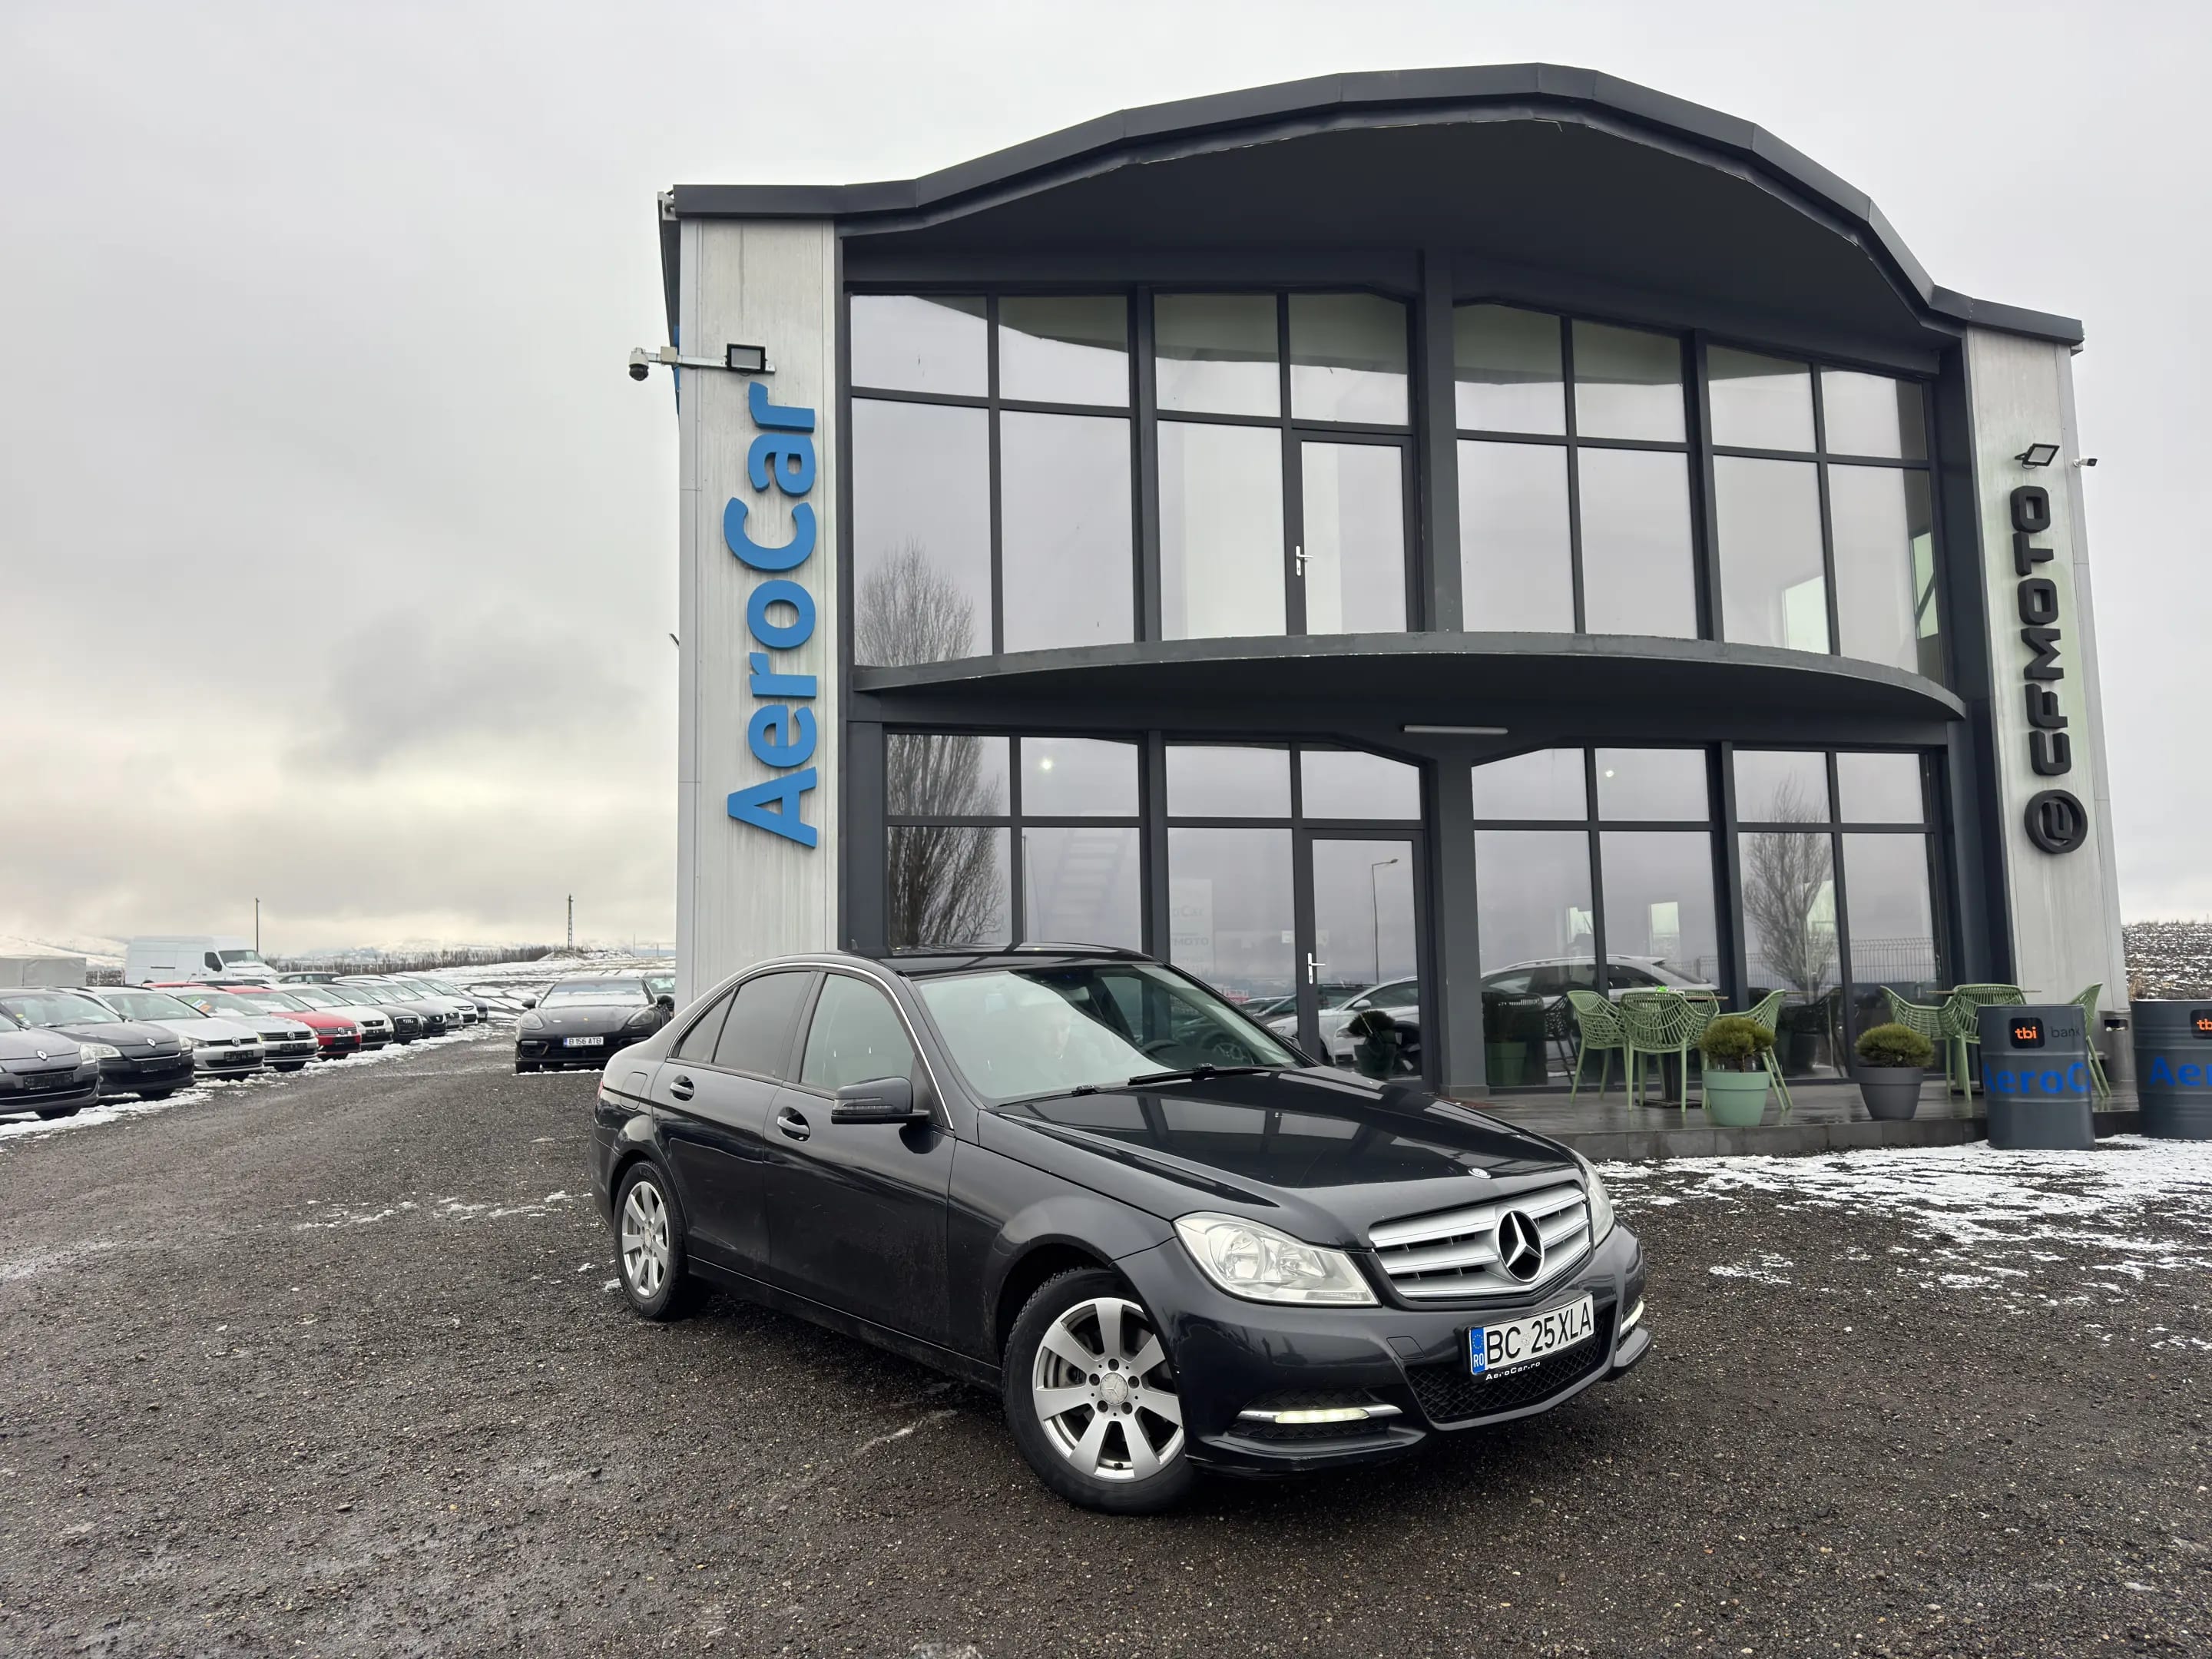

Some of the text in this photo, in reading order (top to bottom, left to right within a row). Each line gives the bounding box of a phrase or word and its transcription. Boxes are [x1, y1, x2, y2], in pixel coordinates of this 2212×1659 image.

[724, 382, 817, 848] AeroCar
[2010, 485, 2072, 777] CFMOTO
[2015, 1026, 2081, 1039] tbi bank
[1473, 1353, 1485, 1367] RO
[1486, 1326, 1522, 1365] BC
[1485, 1361, 1541, 1381] AeroCar.ro
